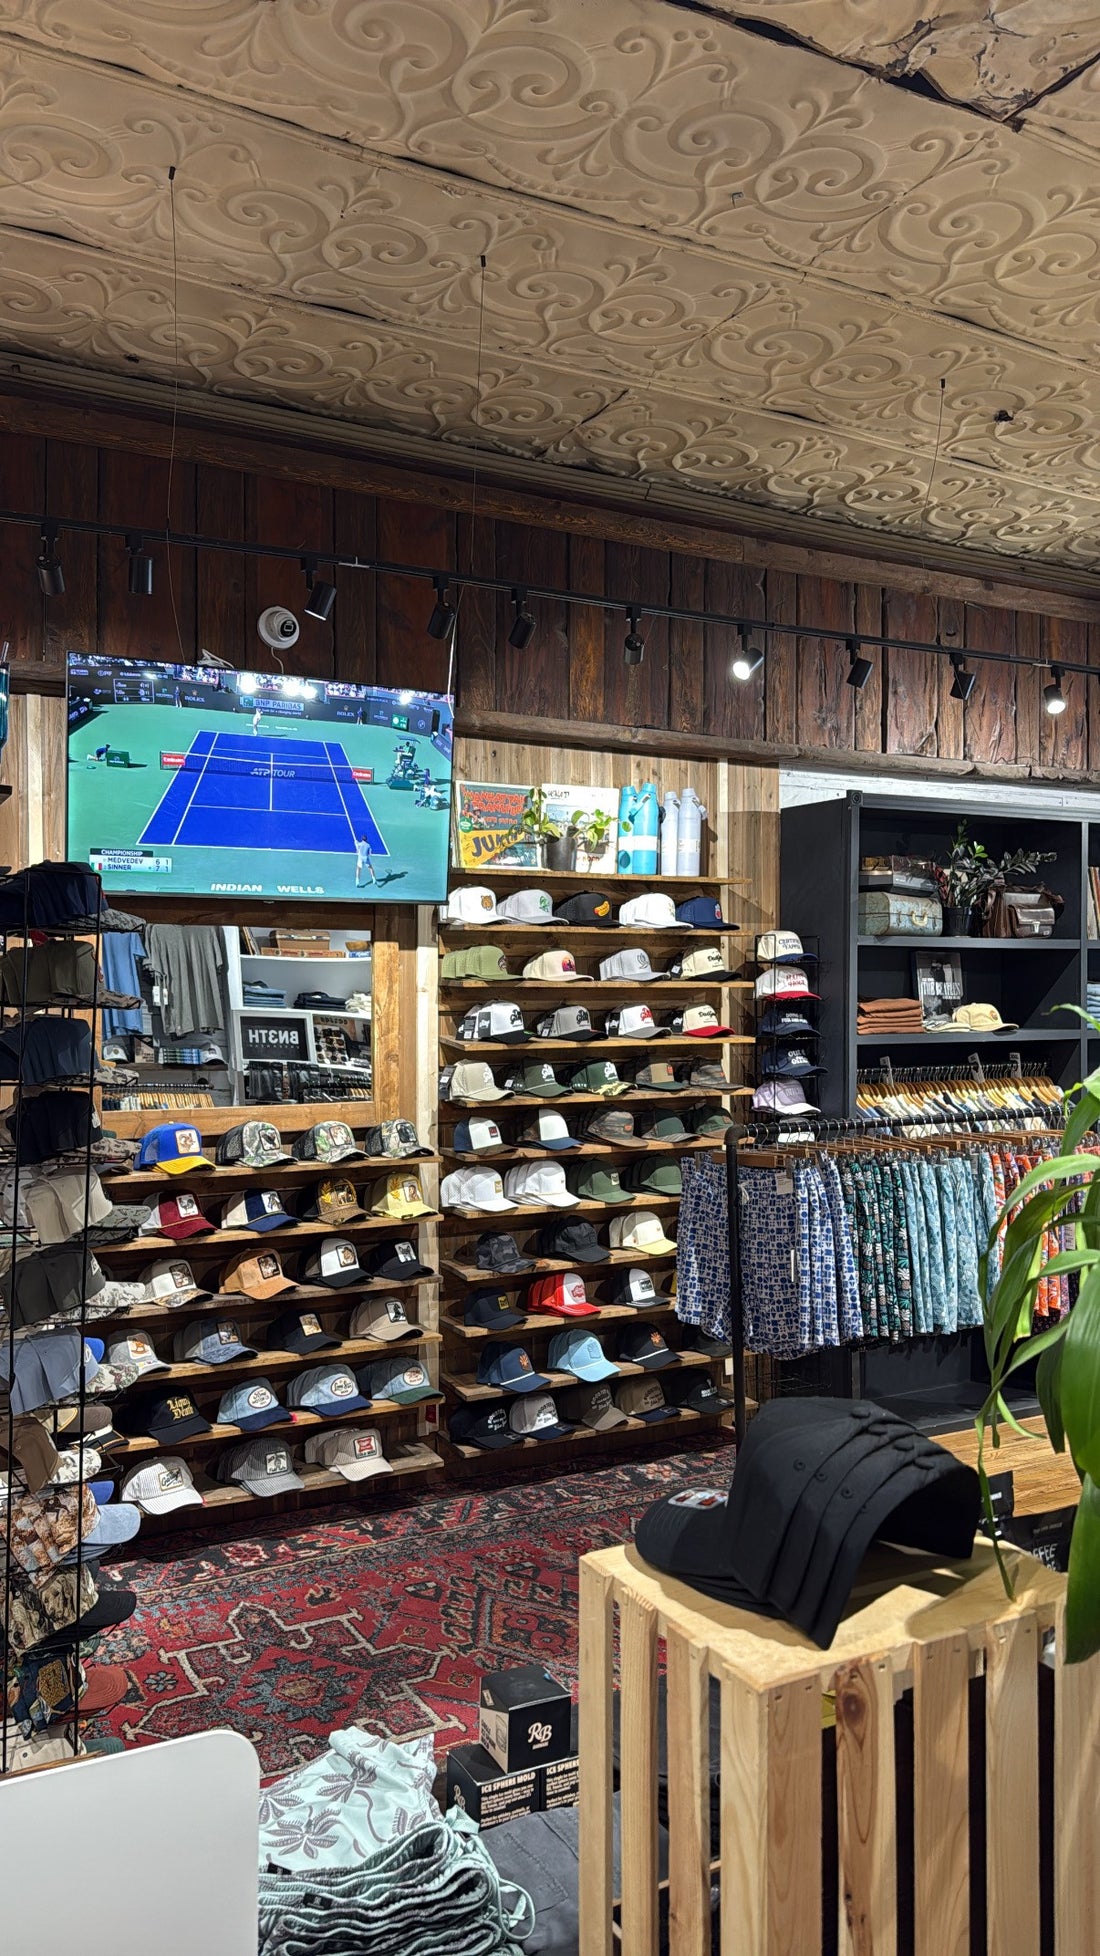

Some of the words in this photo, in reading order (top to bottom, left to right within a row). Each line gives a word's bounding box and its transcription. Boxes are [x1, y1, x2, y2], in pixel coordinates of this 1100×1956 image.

[255, 699, 269, 707] BNP
[272, 701, 302, 710] PARIBAS
[272, 769, 296, 778] TOUR
[101, 849, 143, 857] CHAMPIONSHIP
[210, 883, 262, 892] INDIAN
[277, 885, 324, 894] WELLS
[528, 1722, 552, 1743] RB
[546, 1765, 557, 1776] ICE
[481, 1785, 492, 1794] ICE
[493, 1777, 517, 1791] SPHERE
[517, 1771, 536, 1784] MOLD
